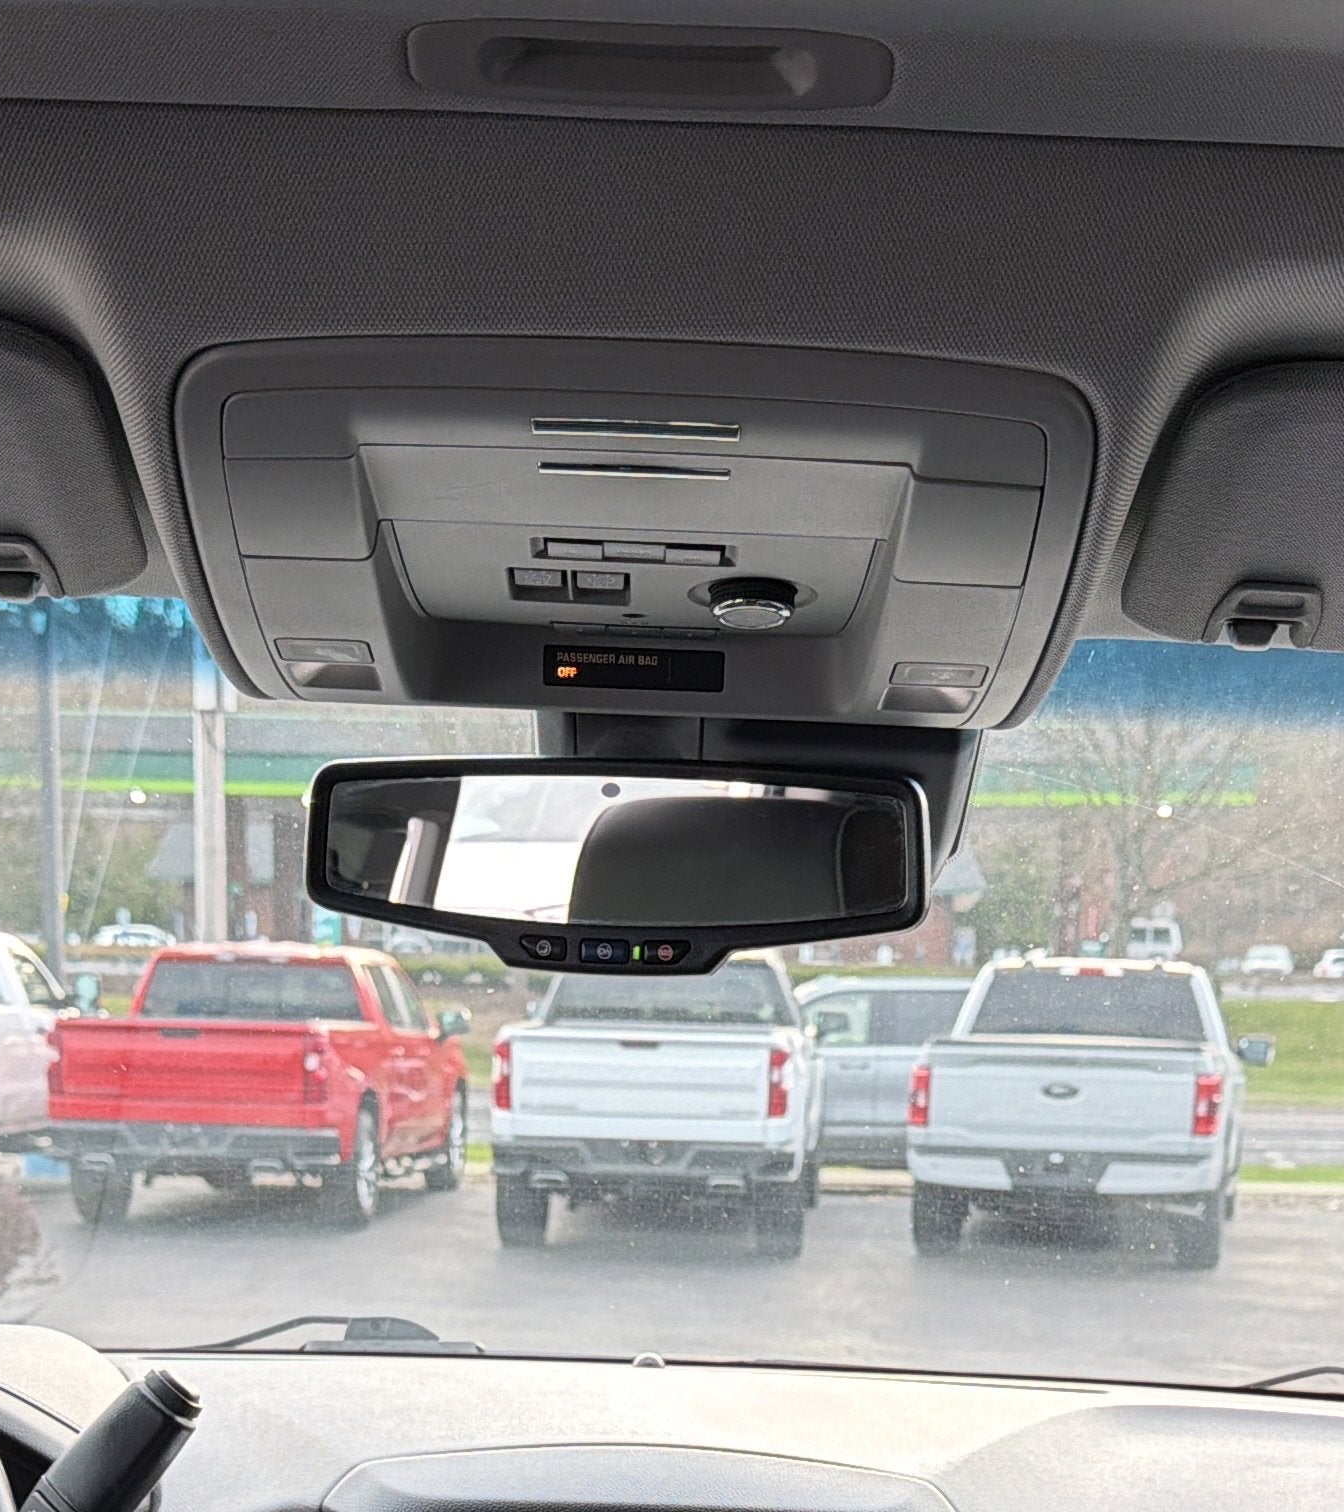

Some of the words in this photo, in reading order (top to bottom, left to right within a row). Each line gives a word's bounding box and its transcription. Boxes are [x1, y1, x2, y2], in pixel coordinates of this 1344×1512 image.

[557, 651, 616, 665] PASSENGER
[617, 653, 636, 665] AIR
[638, 655, 658, 666] BAG
[557, 666, 579, 679] OFF
